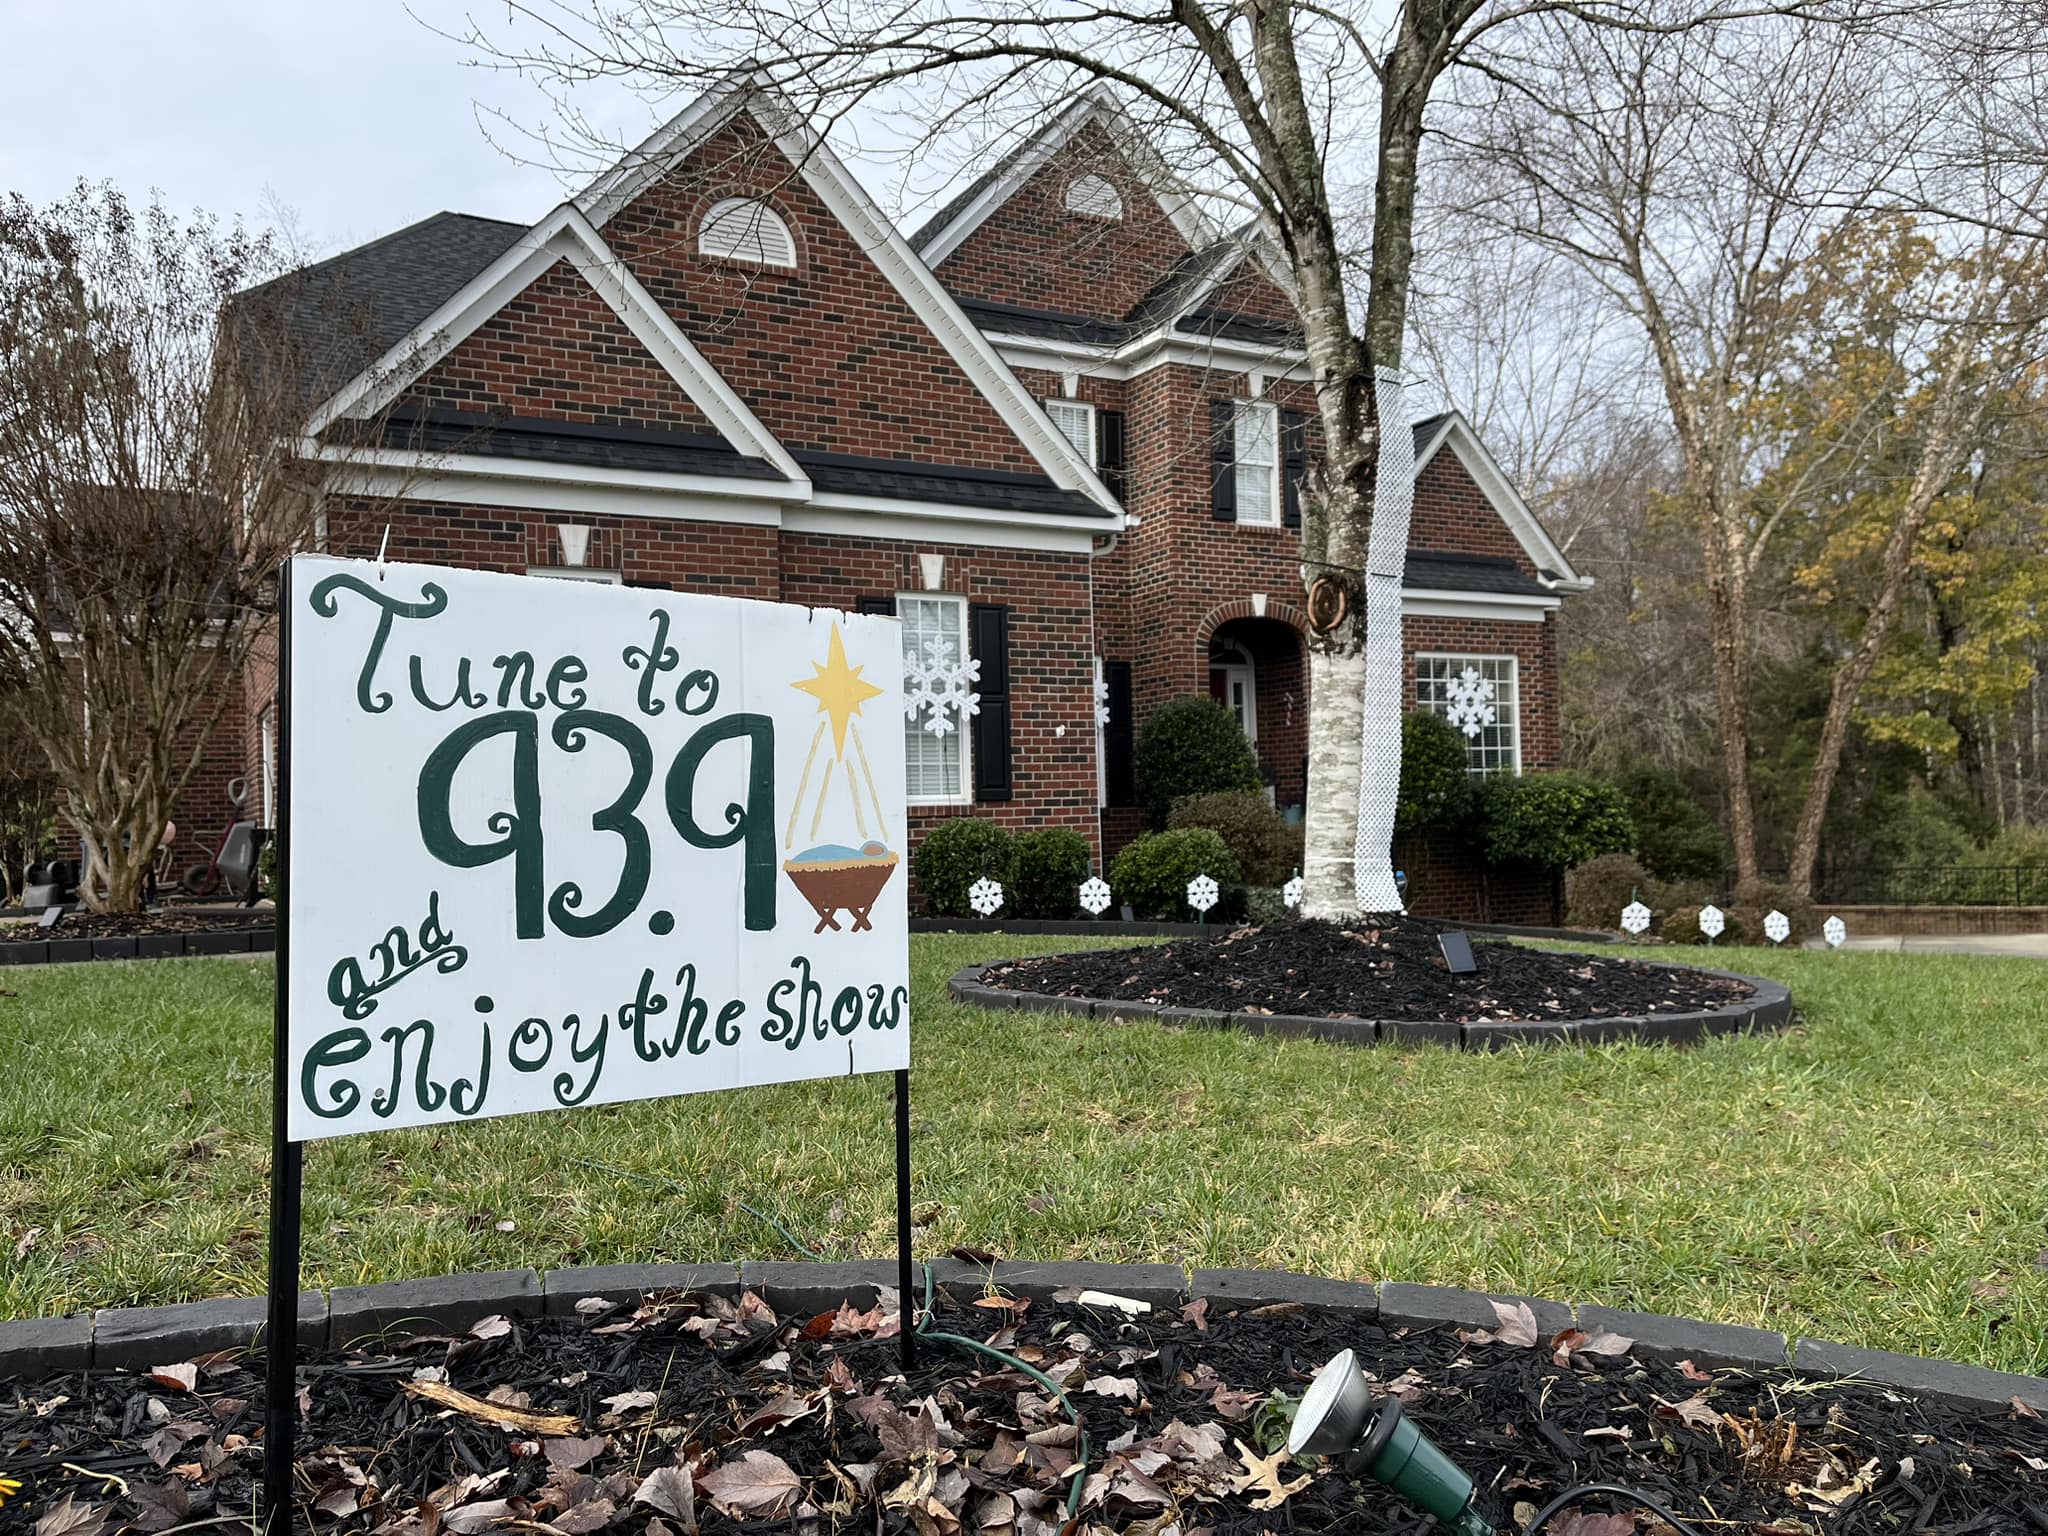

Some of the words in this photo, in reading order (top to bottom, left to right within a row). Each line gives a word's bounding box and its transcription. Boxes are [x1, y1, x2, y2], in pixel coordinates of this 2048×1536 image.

[309, 573, 588, 713] Tune
[622, 608, 720, 716] to
[417, 709, 778, 940] 93.9
[327, 890, 468, 1019] and
[300, 995, 609, 1119] enjoy
[618, 963, 746, 1063] the
[760, 955, 908, 1051] show
